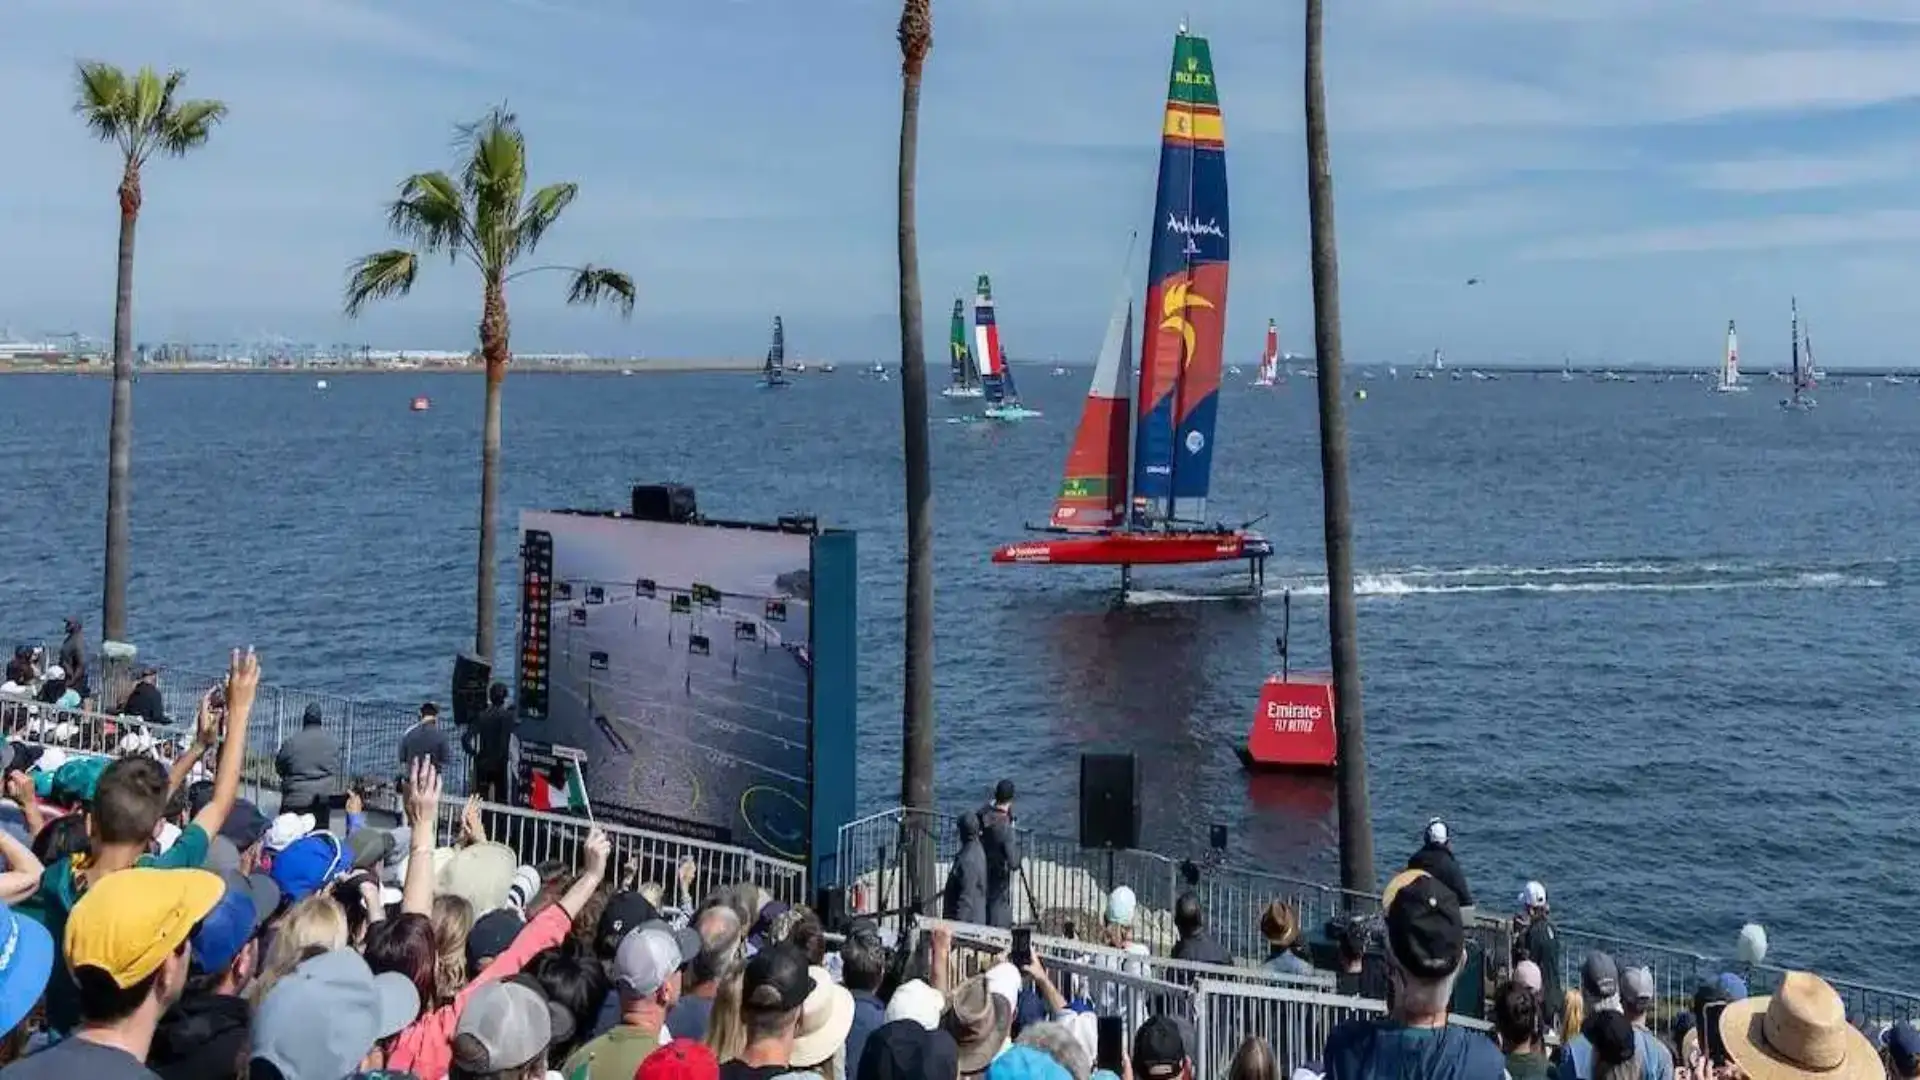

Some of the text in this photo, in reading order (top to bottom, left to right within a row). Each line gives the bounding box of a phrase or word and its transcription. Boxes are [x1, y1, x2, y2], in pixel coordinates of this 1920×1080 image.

[1175, 71, 1212, 85] ROLEX
[1267, 701, 1322, 719] Emirates
[1275, 719, 1287, 732] FLY
